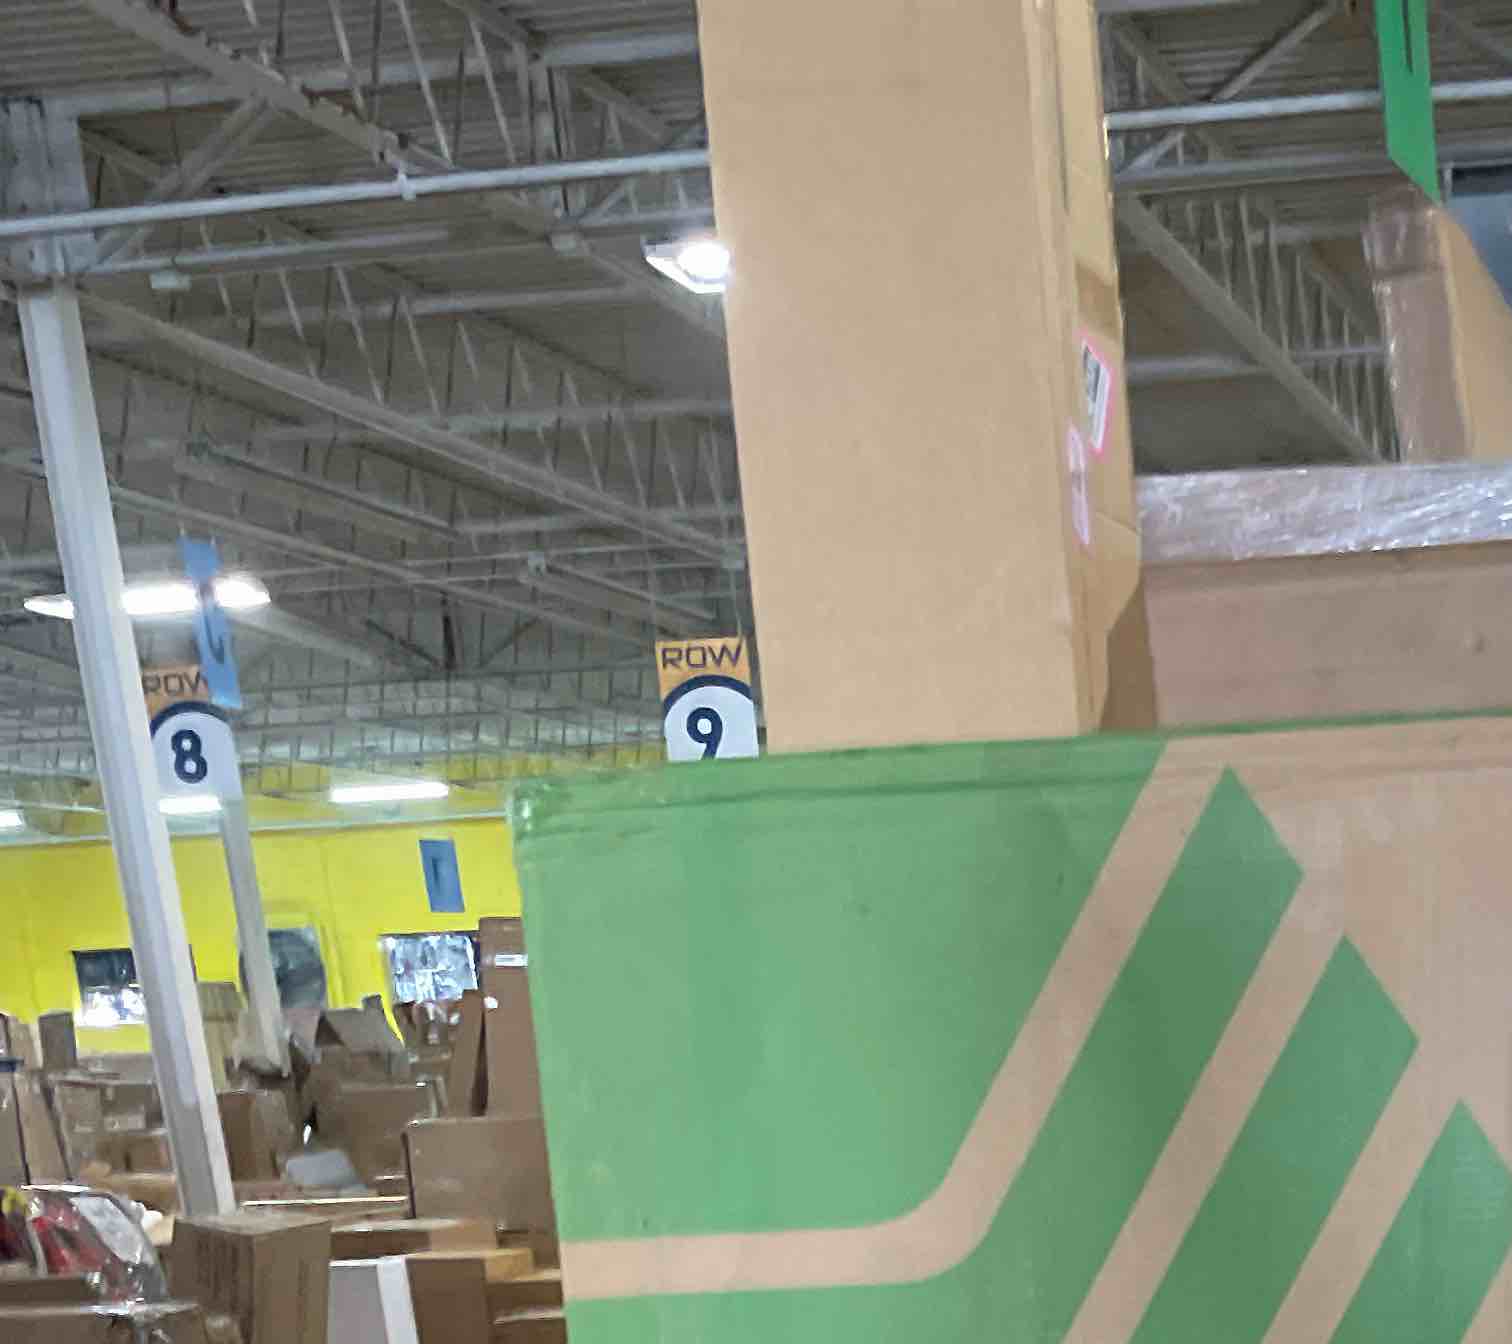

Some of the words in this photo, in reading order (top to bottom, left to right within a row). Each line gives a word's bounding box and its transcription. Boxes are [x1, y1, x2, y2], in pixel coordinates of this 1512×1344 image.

[662, 643, 742, 670] ROW
[171, 729, 207, 784] 8
[686, 706, 723, 759] 9
